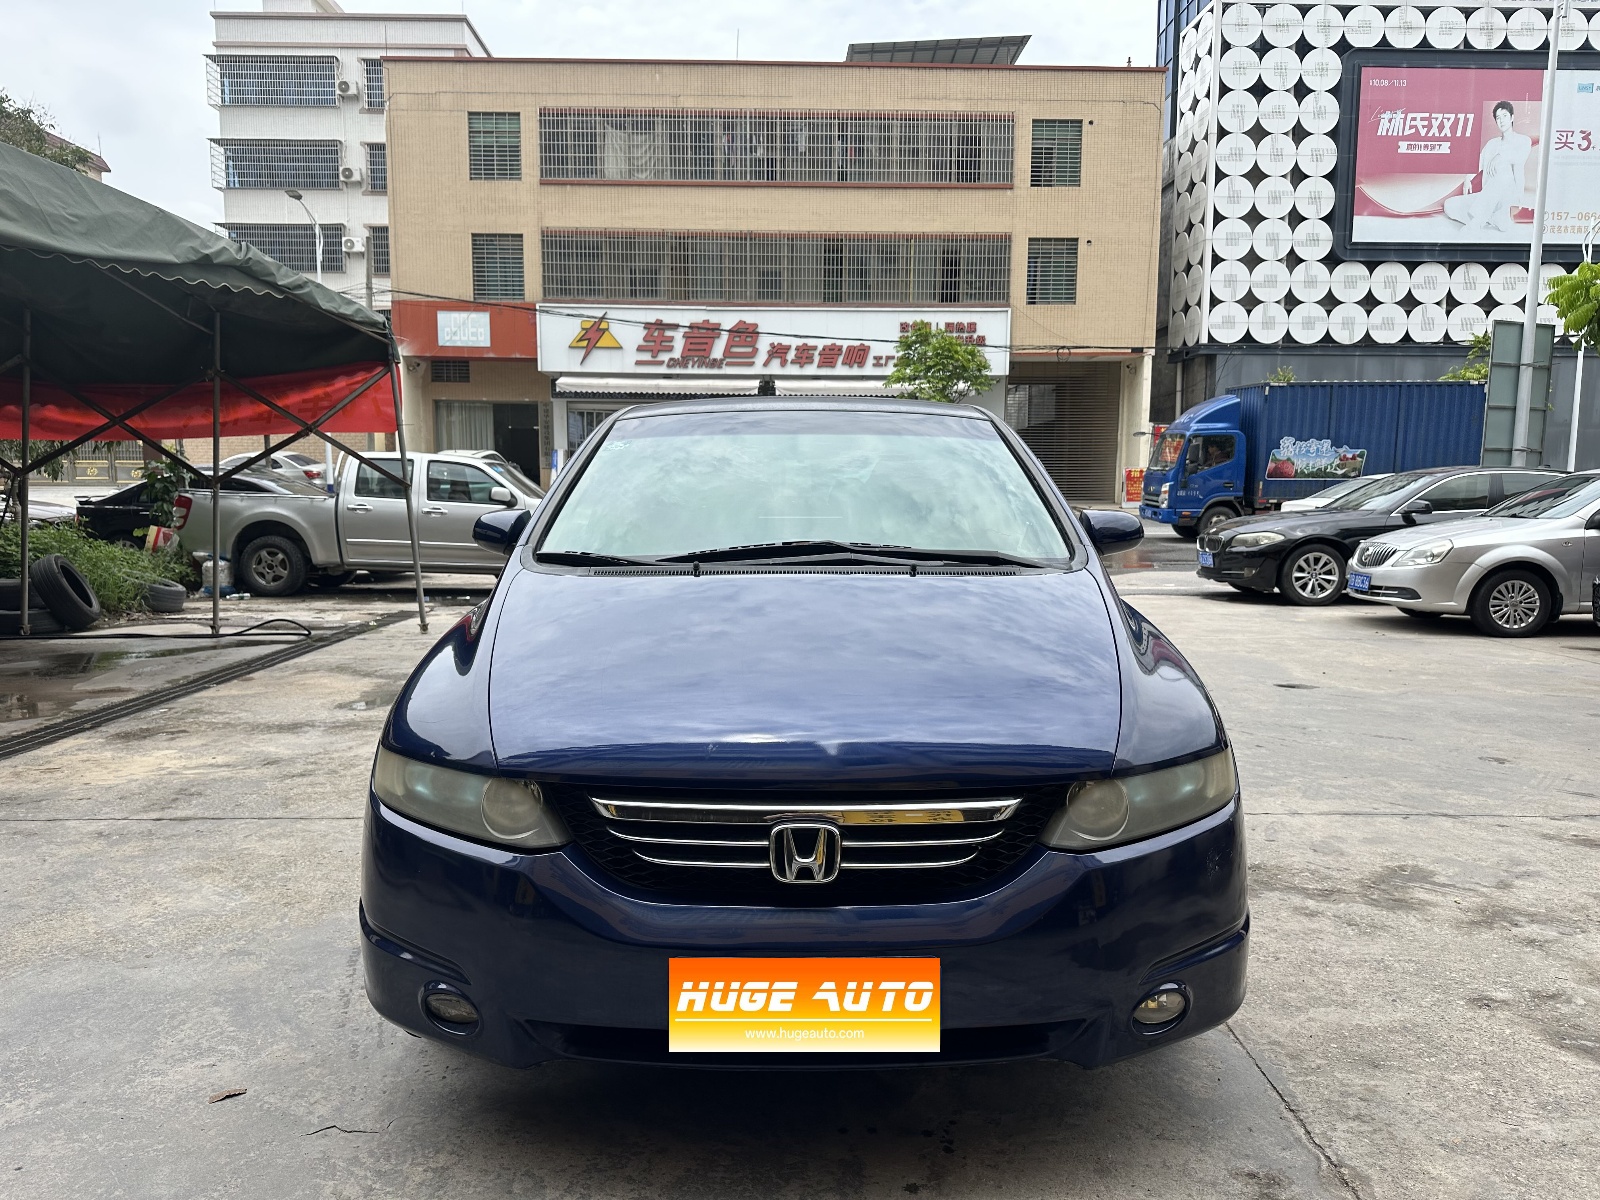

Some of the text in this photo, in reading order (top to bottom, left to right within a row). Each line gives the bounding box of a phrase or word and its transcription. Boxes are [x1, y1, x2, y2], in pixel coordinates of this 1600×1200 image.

[636, 318, 760, 359] 车音色
[762, 342, 871, 368] 汽车音响
